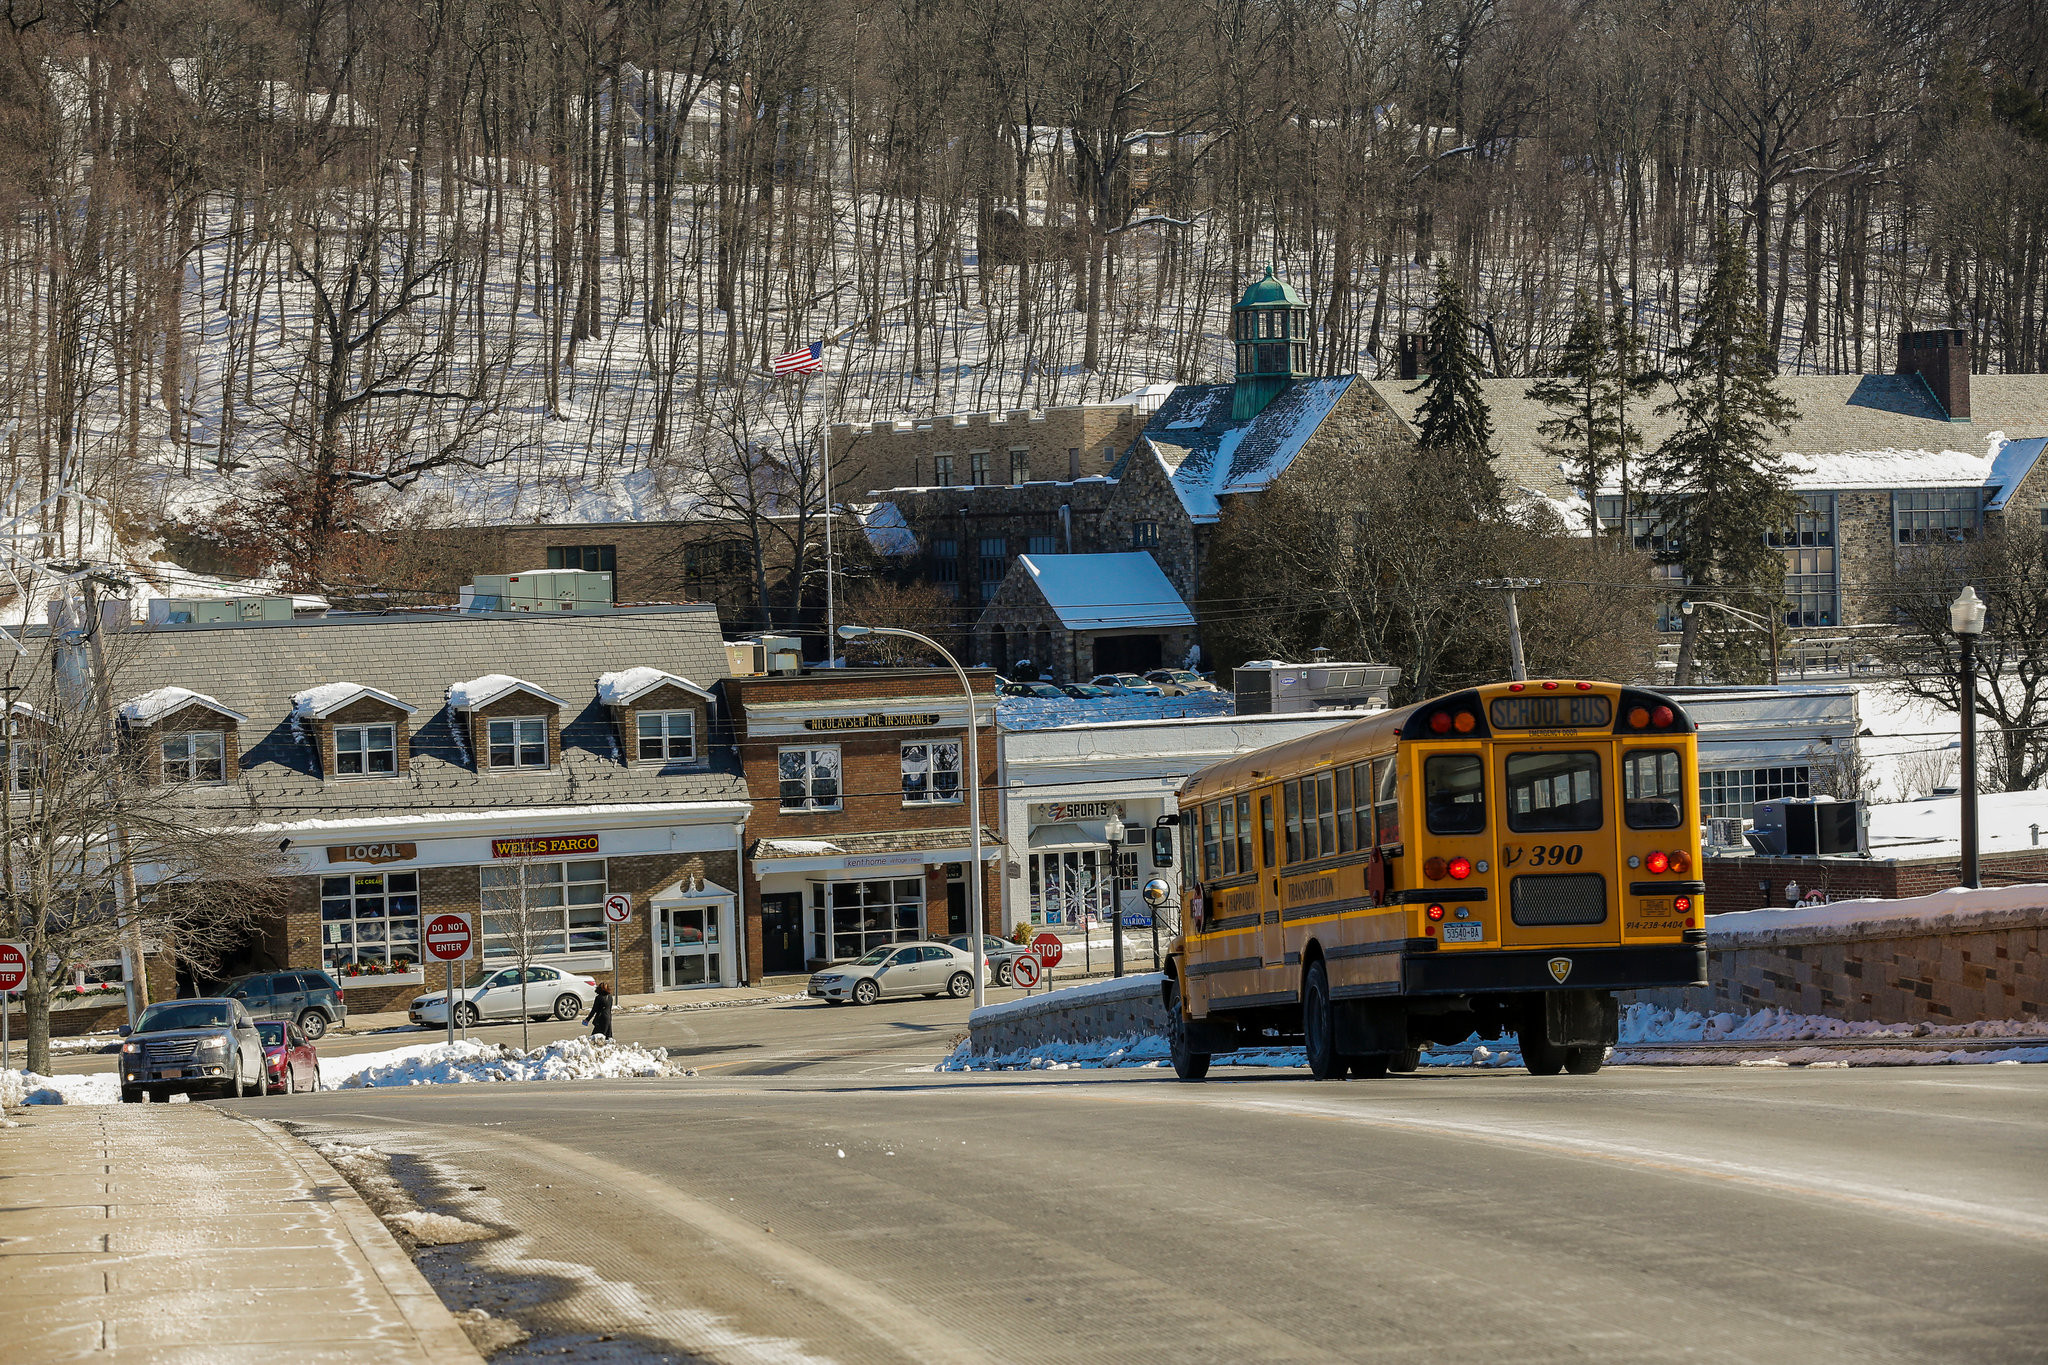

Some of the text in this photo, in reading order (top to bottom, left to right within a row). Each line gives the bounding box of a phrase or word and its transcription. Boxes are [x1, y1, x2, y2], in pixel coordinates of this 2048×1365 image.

[1494, 698, 1605, 725] SCHOOL BUS
[885, 714, 932, 726] INSURANCE
[1066, 802, 1108, 818] SPORTS
[346, 843, 401, 860] LOCAL
[496, 837, 598, 854] WELLS FARGO
[1528, 844, 1584, 867] 390
[847, 858, 864, 867] kent
[865, 858, 887, 866] home
[1288, 877, 1334, 901] TRANSPORTATION
[432, 922, 464, 932] DO NOT
[1123, 917, 1146, 926] MARION
[436, 943, 462, 952] ENTER
[1034, 943, 1061, 958] STOP
[3, 953, 19, 961] NOT
[0, 973, 16, 982] TER
